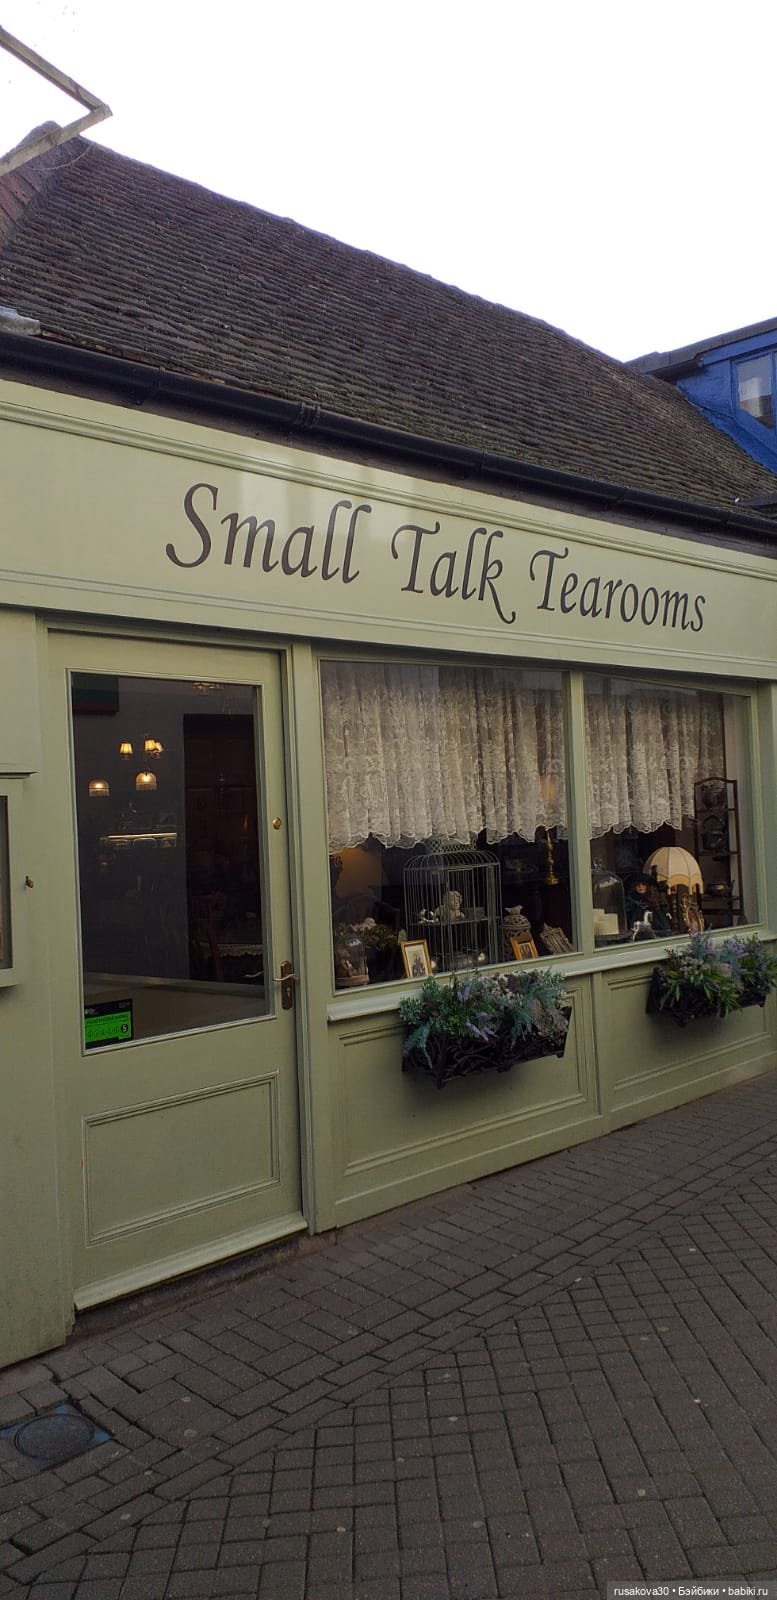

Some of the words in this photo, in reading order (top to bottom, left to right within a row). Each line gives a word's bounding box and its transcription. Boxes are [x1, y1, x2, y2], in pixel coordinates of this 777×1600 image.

[165, 482, 372, 584] Small
[391, 521, 516, 624] Talk
[529, 547, 707, 632] Tearooms
